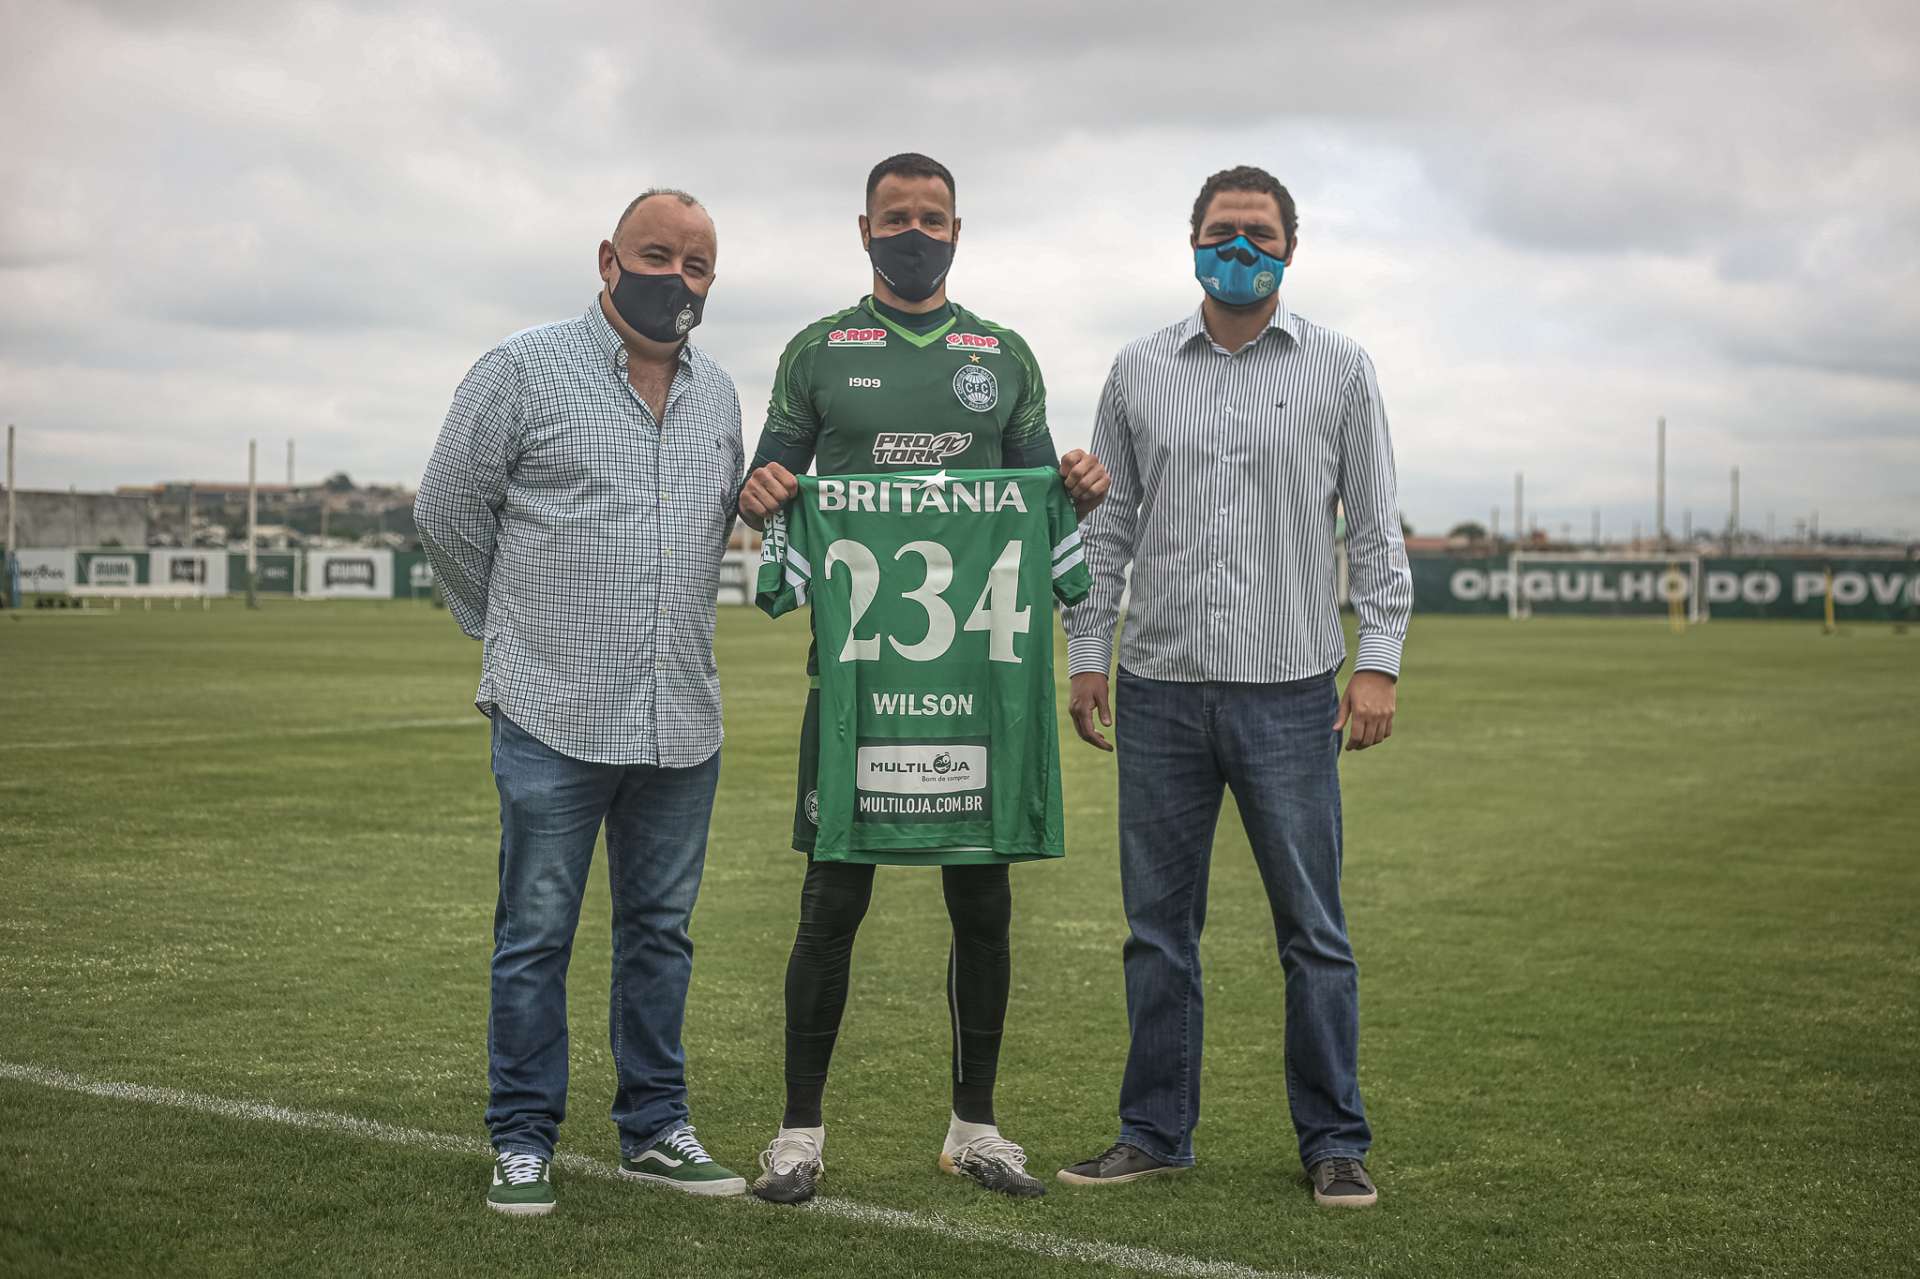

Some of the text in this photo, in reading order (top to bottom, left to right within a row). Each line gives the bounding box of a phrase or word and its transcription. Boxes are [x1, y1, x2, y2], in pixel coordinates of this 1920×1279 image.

[846, 329, 886, 341] RDP
[961, 334, 998, 348] RDP
[848, 377, 881, 388] 1909
[965, 382, 989, 394] CFC
[875, 433, 933, 448] PRO
[873, 448, 941, 464] TORK
[1450, 569, 1690, 602] ORGULHO
[1706, 570, 1782, 602] DO
[824, 538, 1032, 664] 234
[872, 692, 973, 716] WILSON
[870, 754, 970, 774] MULTILOJA
[860, 795, 983, 814] MULTILOJA.COM.BR
